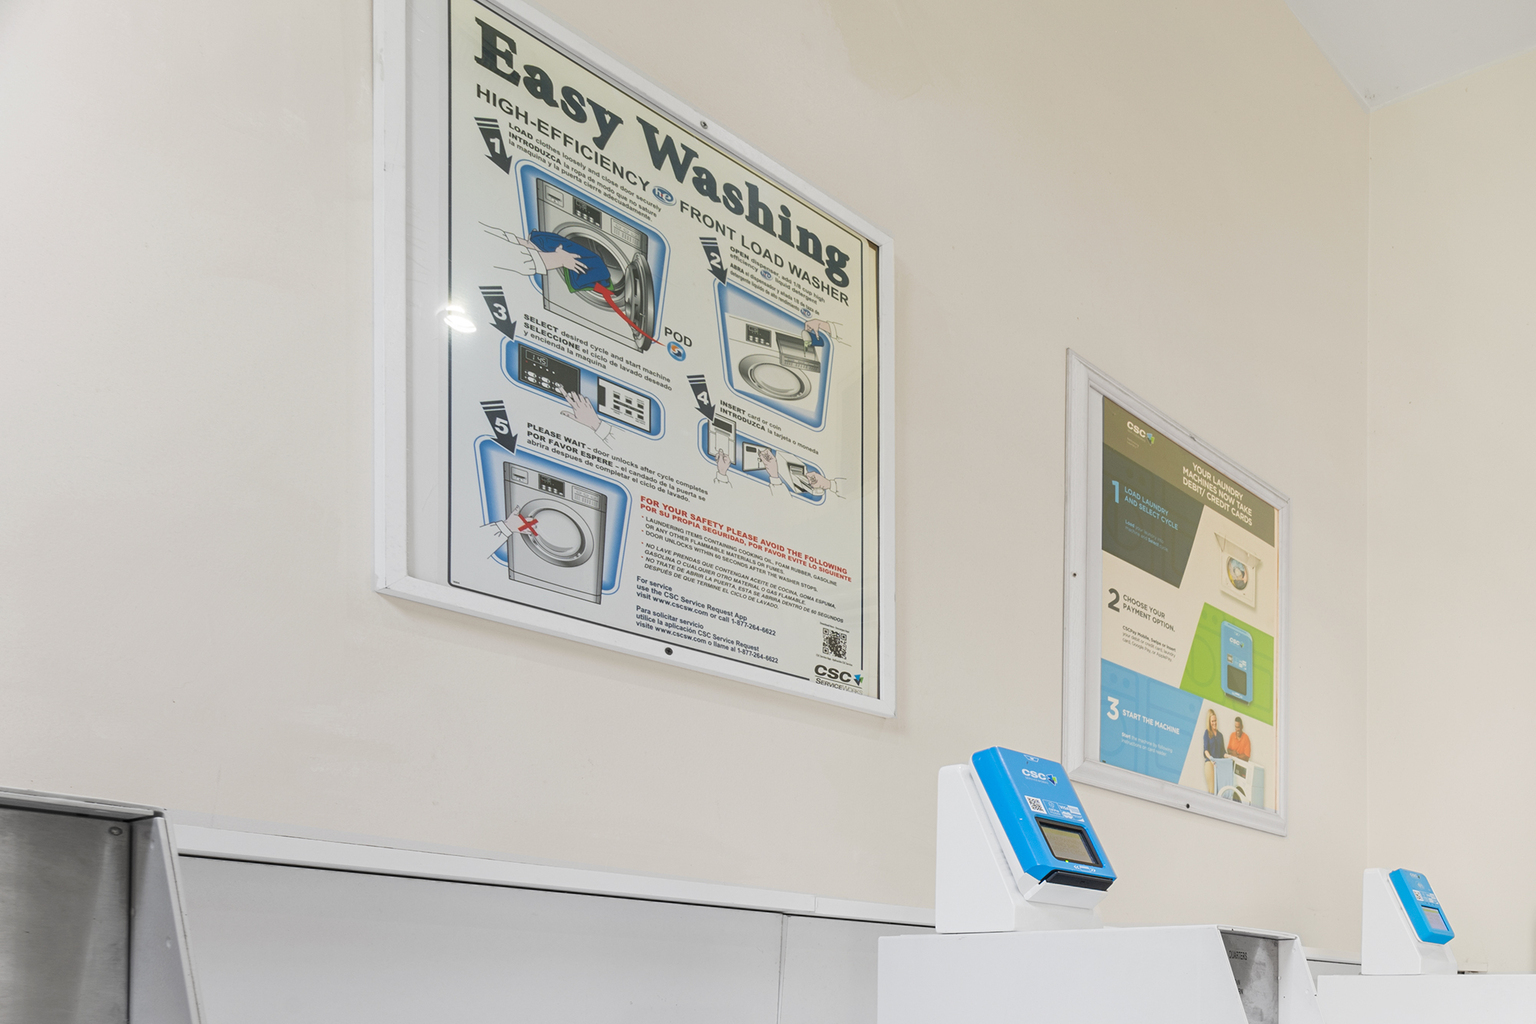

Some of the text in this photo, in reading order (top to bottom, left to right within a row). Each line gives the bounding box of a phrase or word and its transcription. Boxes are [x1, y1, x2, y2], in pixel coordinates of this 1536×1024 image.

[474, 17, 849, 287] Easy Washing
[486, 137, 500, 154] 1
[509, 122, 661, 212] LOAD clothes loosely and close door securely
[476, 83, 848, 306] HIGH-EFFICIENCY FRONT LOAD WASHER
[708, 252, 722, 268] 2
[491, 303, 508, 320] 3
[524, 314, 670, 382] SELECT desired cycle and start machine
[664, 326, 692, 347] POD
[695, 391, 710, 405] 4
[494, 417, 509, 434] 5
[720, 400, 745, 414] INSERT
[747, 413, 760, 422] card
[769, 422, 781, 431] coin
[1127, 421, 1145, 437] CSC
[527, 422, 708, 495] PLEASE WAIT door unlocks after cycle completes
[1111, 480, 1119, 503] 1
[1182, 466, 1252, 516] MACHINES NOW TAKE
[1192, 462, 1243, 500] YOUR LAUNDRY
[1124, 486, 1168, 516] LOAD LAUNDRY
[1124, 495, 1178, 530] AND SELECT CYCLE
[1182, 476, 1252, 525] DEBIT/ CREDIT CARDS
[640, 495, 847, 574] FOR YOUR SAFETY PLEASE AVOID THE FOLLOWING
[636, 575, 672, 591] For service
[636, 591, 650, 600] visit
[652, 596, 708, 616] www.cscsw.com
[731, 618, 775, 636] 1-877-264-6622
[663, 591, 678, 600] CSC
[680, 596, 705, 608] Service
[706, 604, 733, 616] Request
[734, 612, 747, 623] App
[1107, 588, 1119, 612] 2
[1122, 594, 1165, 618] CHOOSE YOUR
[1123, 602, 1175, 632] PAYMENT OPTION.
[814, 664, 851, 682] CSC
[1106, 696, 1119, 720] 3
[1122, 709, 1179, 734] START THE MACHINE
[1022, 769, 1046, 780] CSC
